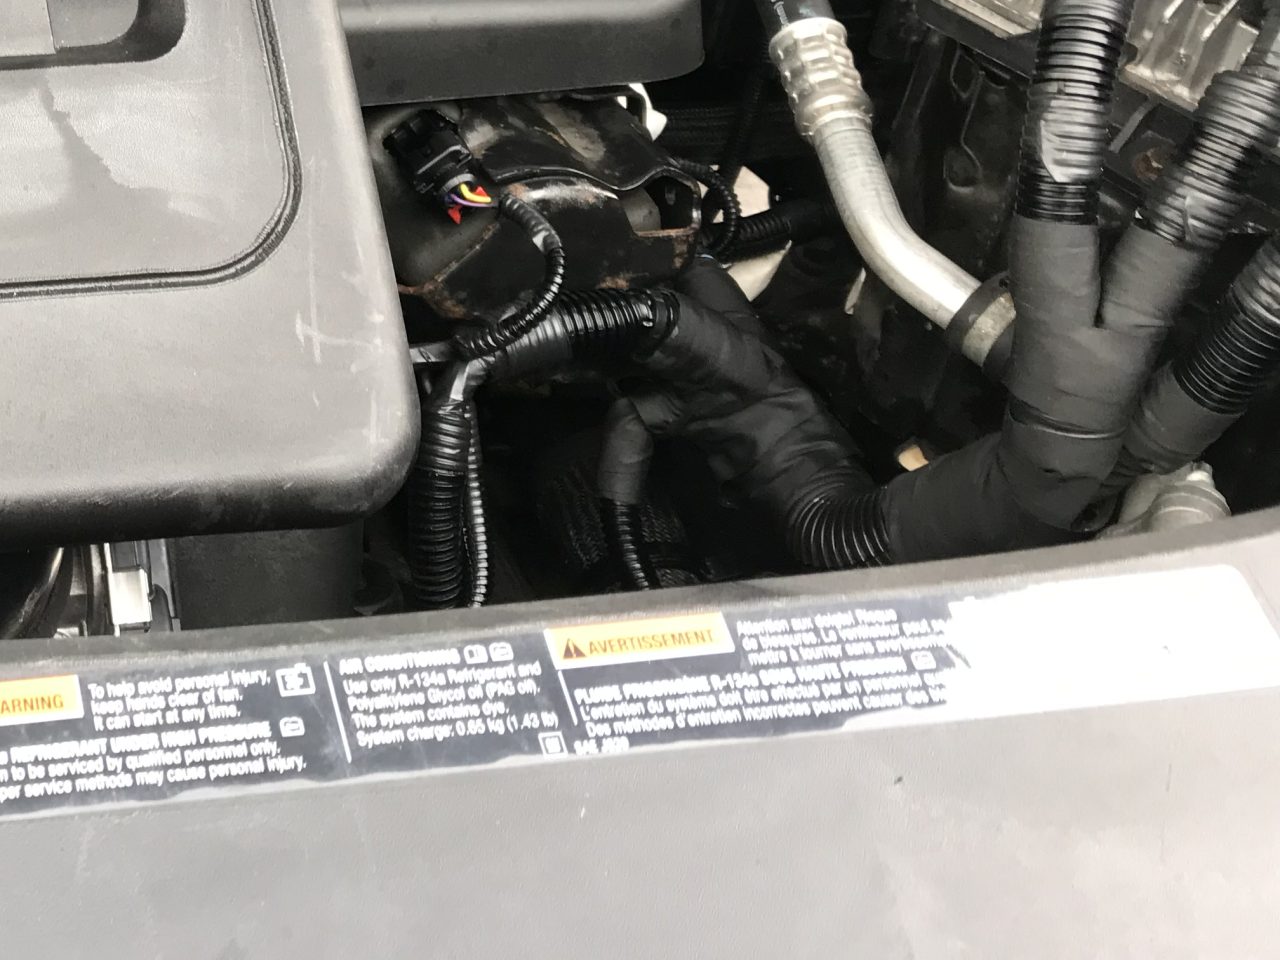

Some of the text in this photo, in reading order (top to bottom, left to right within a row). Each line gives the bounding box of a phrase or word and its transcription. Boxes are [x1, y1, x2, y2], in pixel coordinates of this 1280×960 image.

[588, 629, 715, 655] AVERTISSEMENT
[87, 683, 105, 699] To
[106, 681, 135, 699] help
[138, 677, 172, 695] avoid
[174, 671, 229, 695] personal
[343, 659, 542, 695] Use only R-134a Refrigerant and
[90, 686, 243, 716] keep hands clear of fan.
[427, 685, 466, 705] Glycol
[486, 680, 515, 700] (PAG
[647, 699, 664, 714] du
[106, 714, 131, 730] can
[133, 709, 163, 727] start
[166, 707, 180, 724] at
[182, 706, 205, 724] any
[207, 703, 241, 720] time.
[351, 700, 509, 729] The system contains dye.
[356, 729, 405, 749] System
[486, 717, 505, 735] kg
[585, 722, 611, 738] Des
[11, 765, 25, 781] to
[27, 763, 45, 779] be
[48, 755, 104, 777] serviced
[106, 755, 122, 773] by
[125, 748, 181, 771] qualified
[184, 741, 248, 766] personnel
[250, 739, 280, 757] only.
[24, 779, 72, 797] service
[75, 772, 133, 792] methods
[135, 770, 164, 787] may
[166, 766, 206, 782] cause
[208, 757, 265, 781] personal
